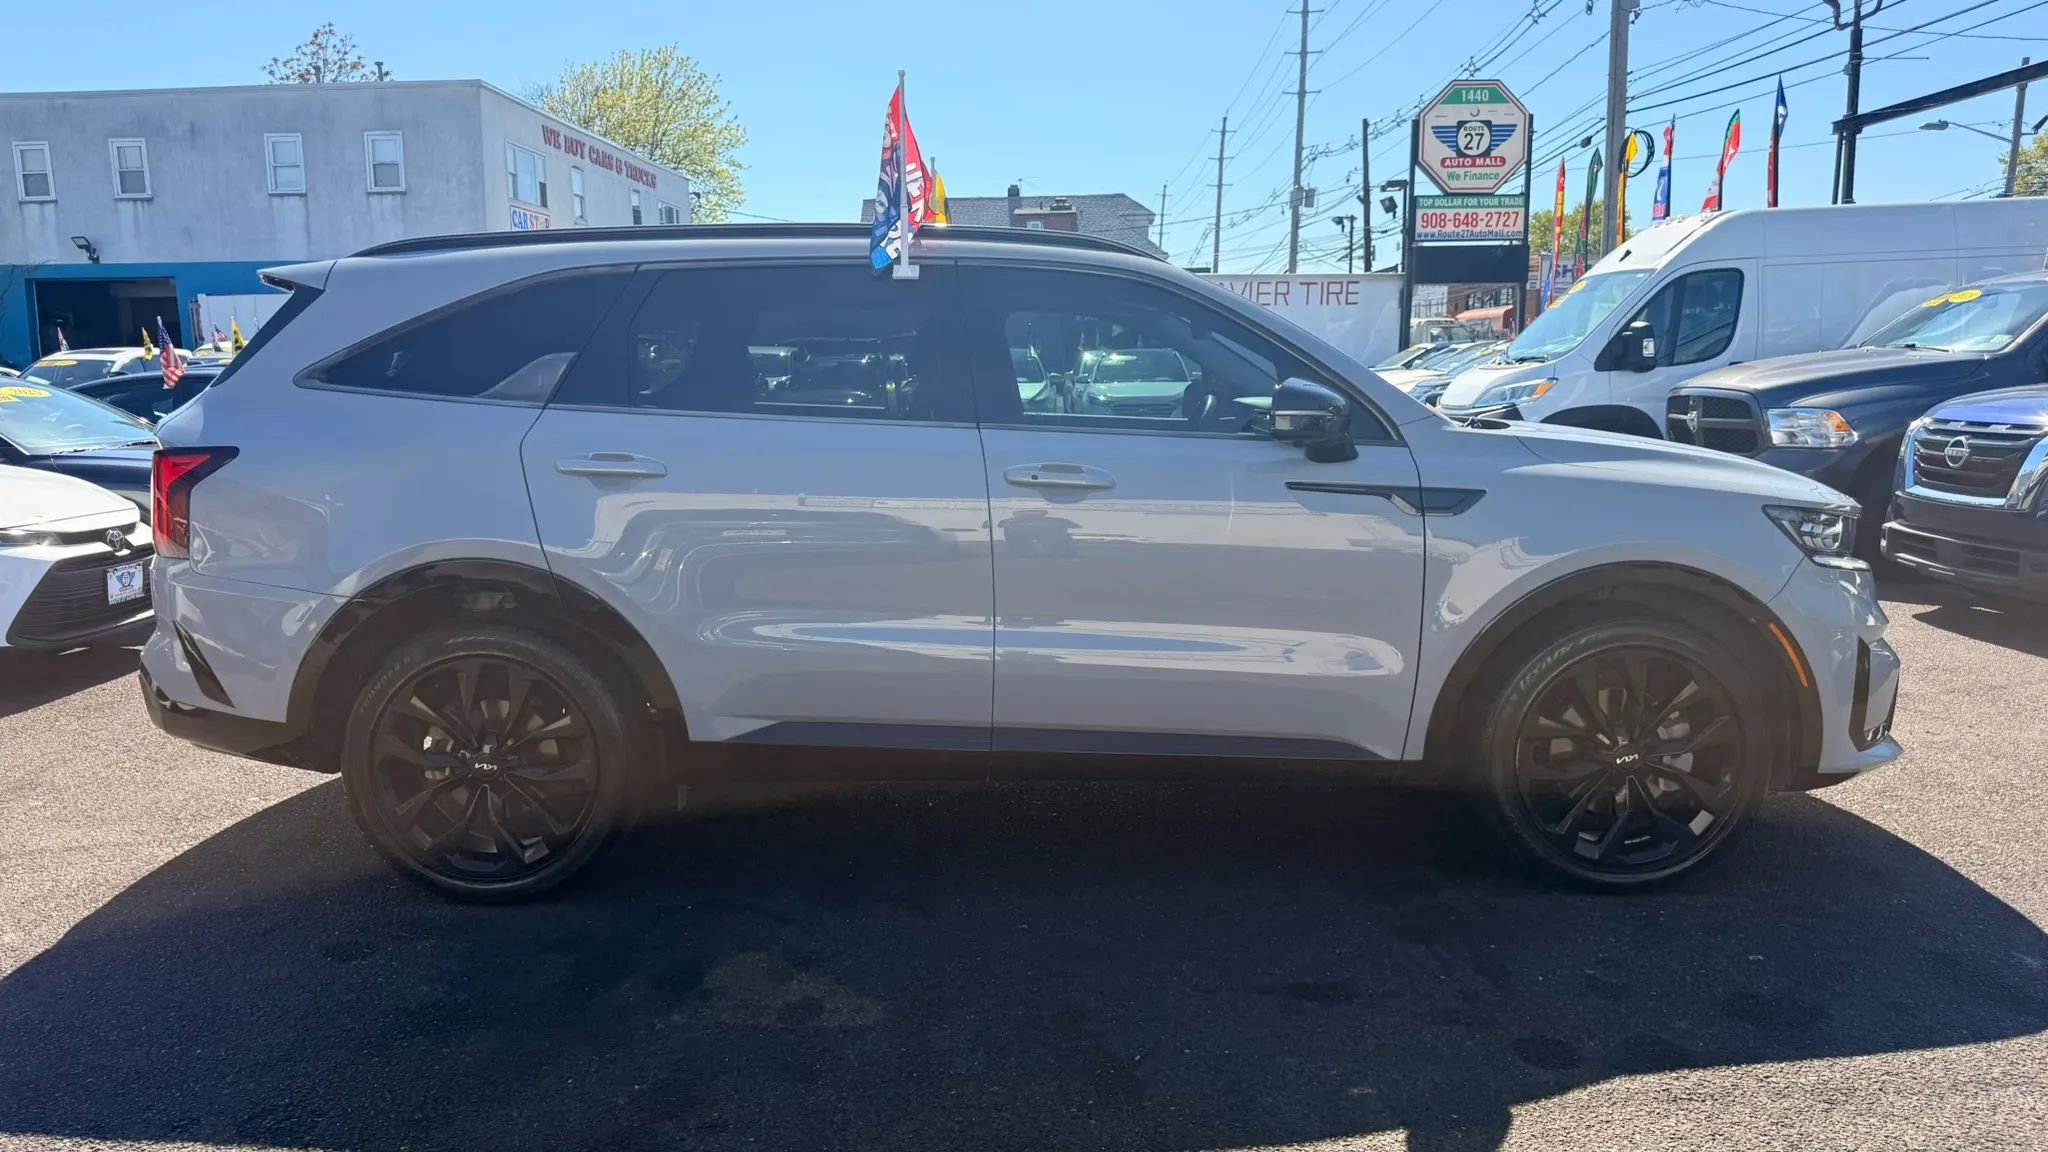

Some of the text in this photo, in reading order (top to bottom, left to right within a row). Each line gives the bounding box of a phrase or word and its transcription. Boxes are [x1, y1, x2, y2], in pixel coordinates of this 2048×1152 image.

[1461, 89, 1489, 102] 1440
[1463, 132, 1485, 151] 27
[541, 124, 657, 189] WE BUY CARS & TRUCKS
[1444, 157, 1503, 167] AUTO MALL
[1446, 170, 1500, 181] We Finance
[1419, 197, 1524, 207] TOP DOLLAR FOR YOUR TRADE
[511, 208, 529, 230] CAR
[1421, 211, 1519, 229] 908-648-2727
[1417, 229, 1524, 239] www.Route27AutoMall.com
[1299, 280, 1360, 306] TIRE
